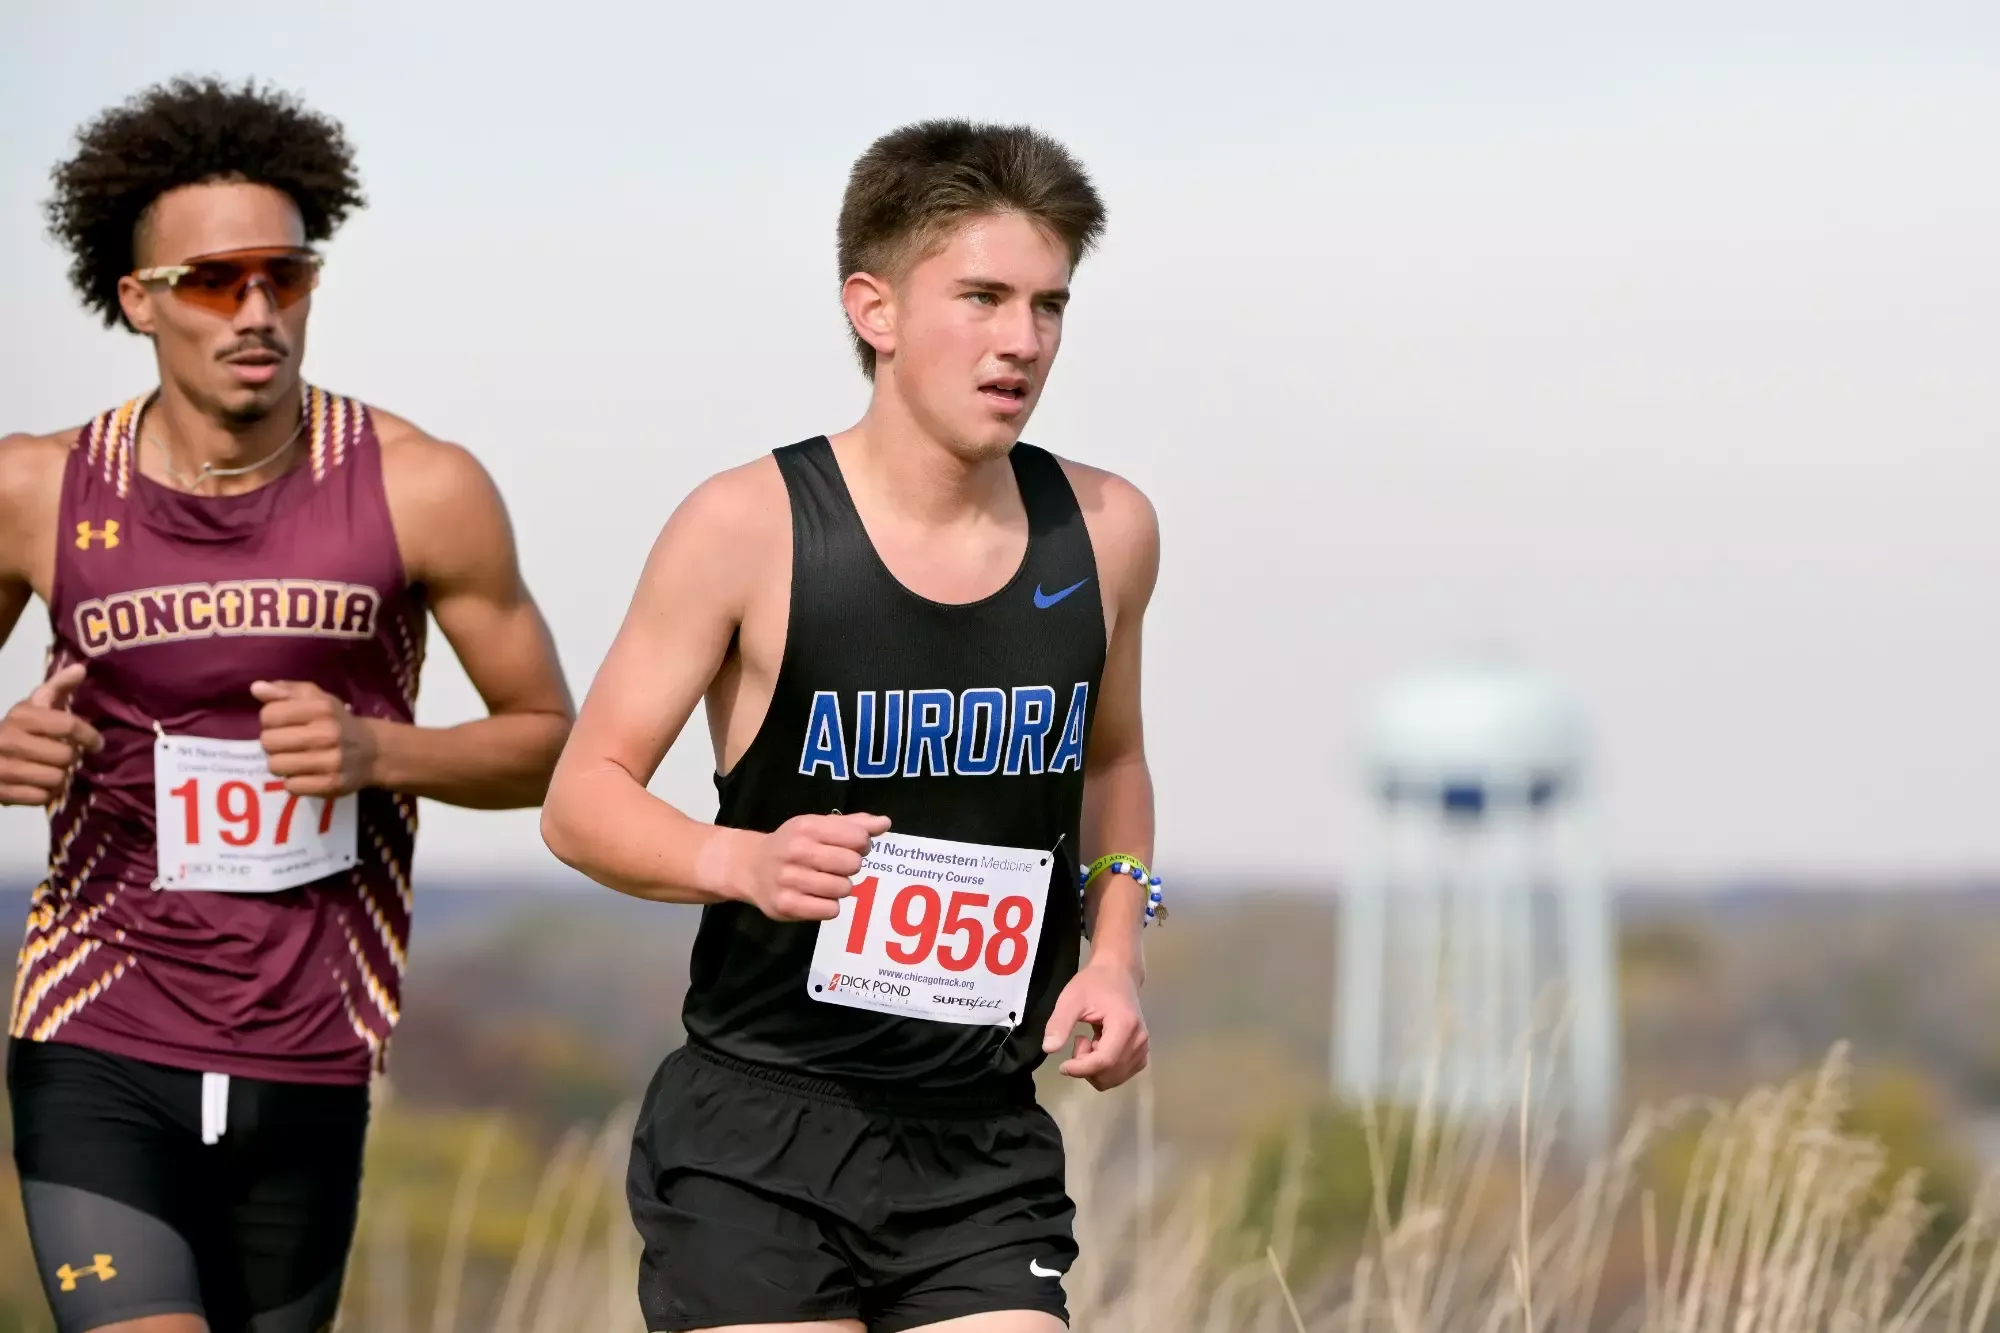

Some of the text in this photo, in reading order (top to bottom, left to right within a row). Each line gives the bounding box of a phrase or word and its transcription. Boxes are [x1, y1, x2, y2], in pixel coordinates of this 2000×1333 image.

[74, 578, 380, 658] CONCORDIA
[797, 681, 1090, 781] AURORA
[860, 857, 985, 886] Cross Country Course
[883, 842, 979, 868] Northwestern
[980, 856, 1033, 873] Medicine
[845, 875, 1034, 976] 1958
[839, 974, 911, 998] DICK POND
[878, 966, 975, 991] www.chicagotrack.org
